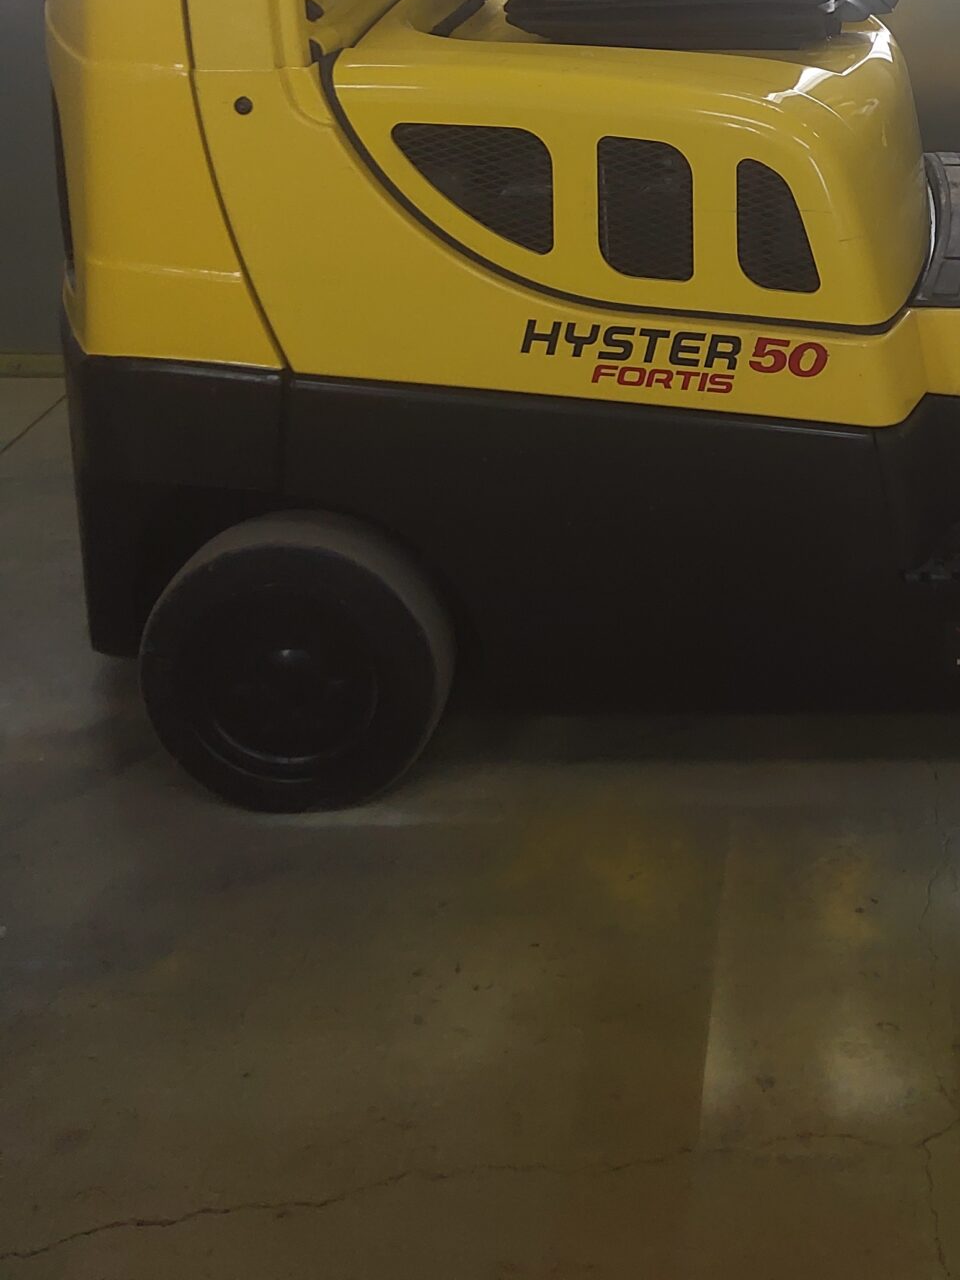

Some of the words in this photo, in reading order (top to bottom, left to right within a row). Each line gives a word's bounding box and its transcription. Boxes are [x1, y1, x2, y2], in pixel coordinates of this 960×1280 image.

[520, 319, 742, 370] HYSTER
[748, 337, 829, 378] 50
[591, 364, 735, 394] FORTIS
